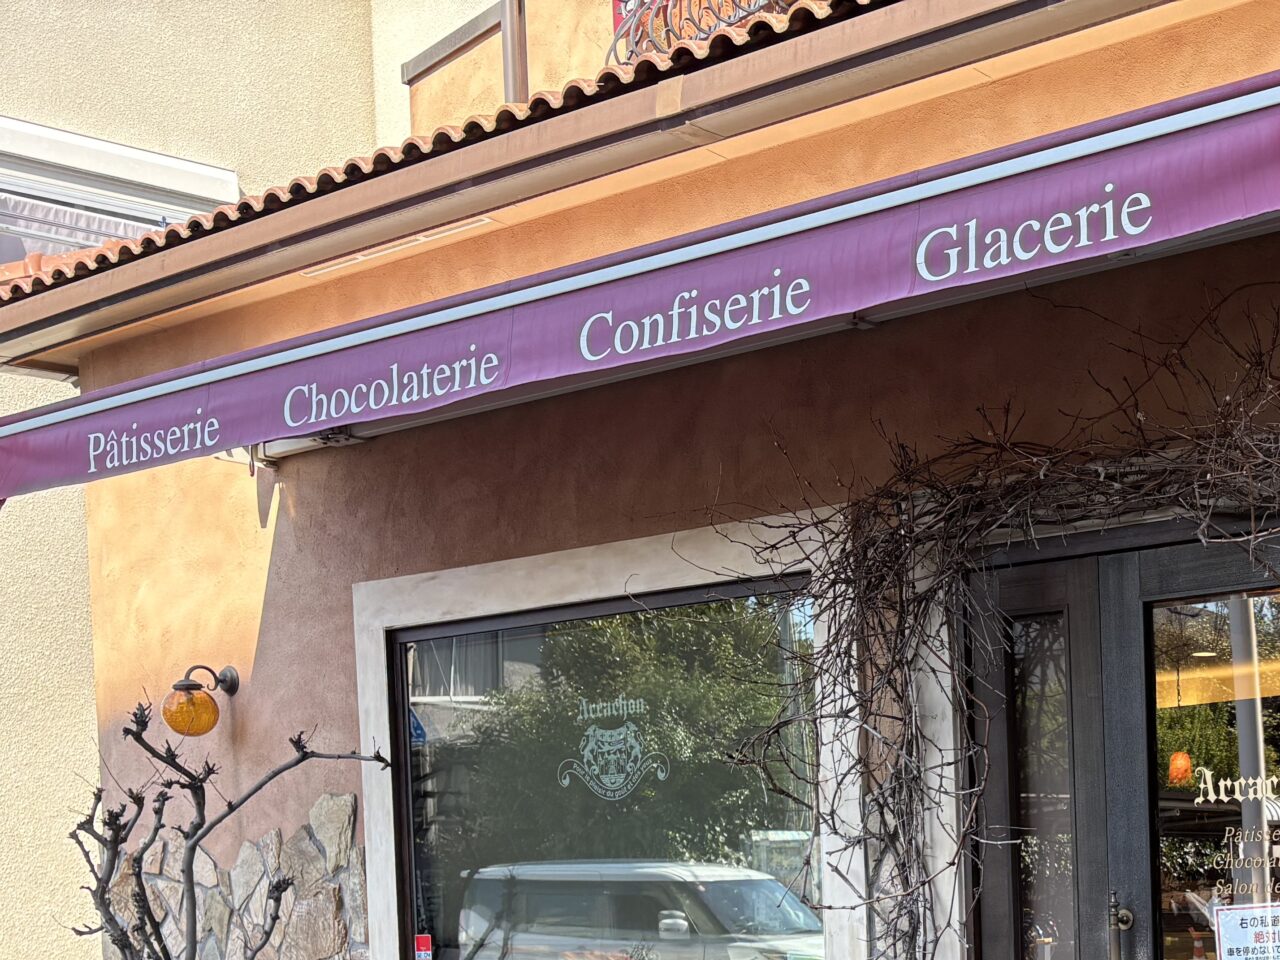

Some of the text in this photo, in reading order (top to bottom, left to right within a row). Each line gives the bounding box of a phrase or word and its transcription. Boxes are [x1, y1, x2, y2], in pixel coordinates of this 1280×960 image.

[87, 184, 1152, 474] Pâtisserie Chocolaterie Confiserie Glacerie
[1215, 878, 1257, 895] Salon
